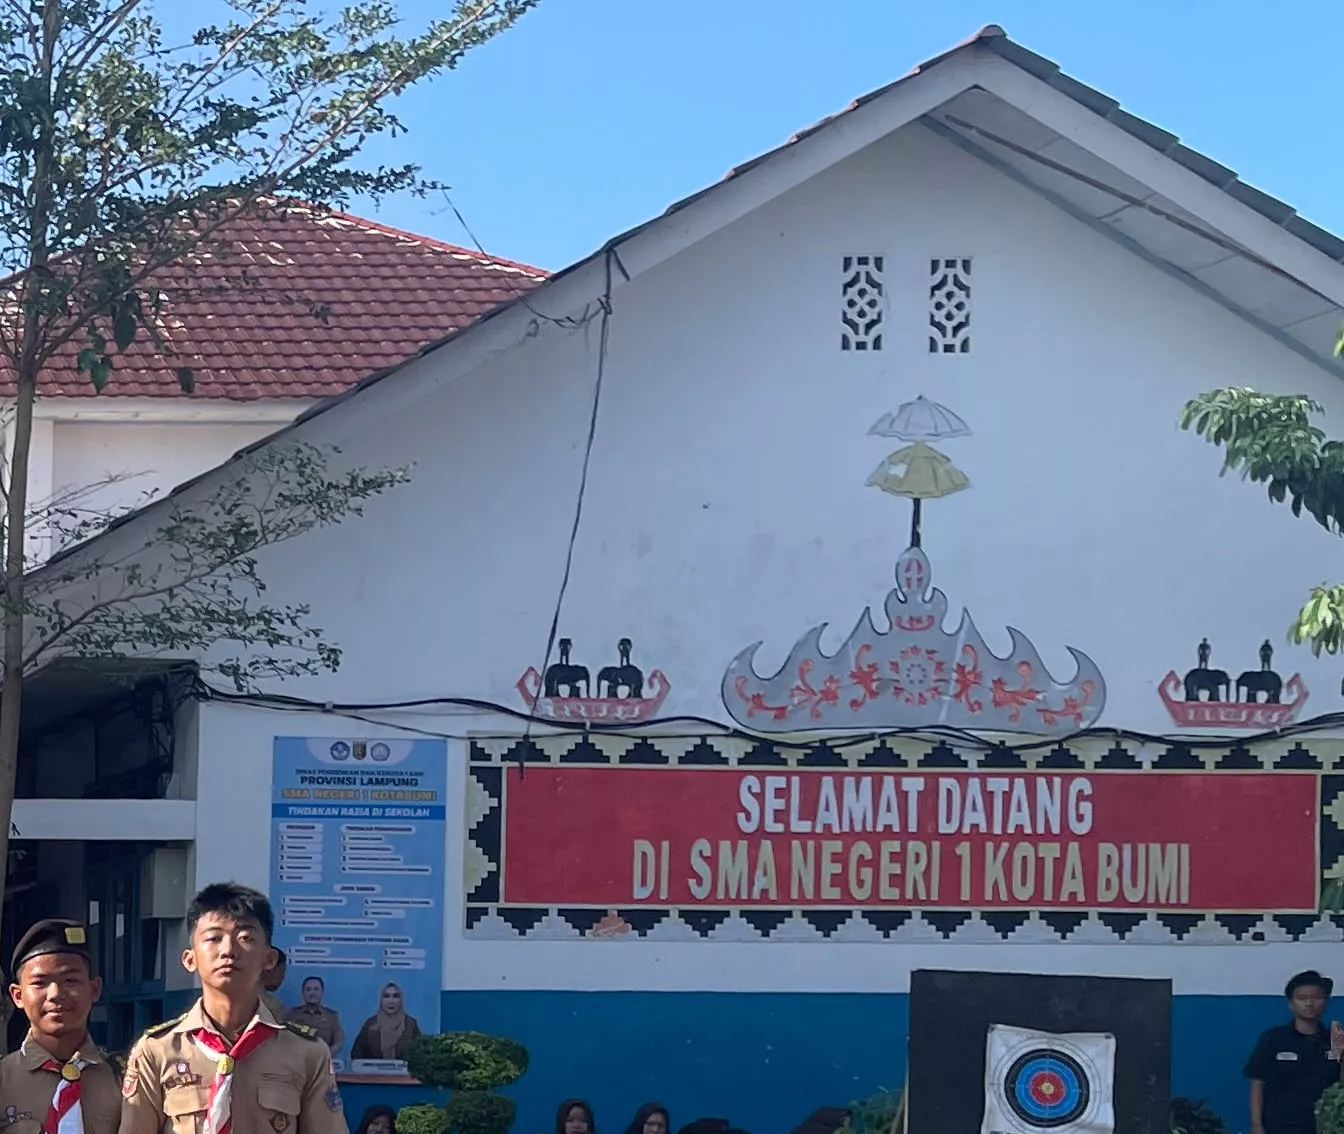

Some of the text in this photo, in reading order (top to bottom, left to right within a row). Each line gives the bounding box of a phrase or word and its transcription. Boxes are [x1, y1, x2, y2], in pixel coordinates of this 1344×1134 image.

[300, 776, 419, 787] PROVINSI LAMPUNG
[282, 788, 310, 799] SMA
[288, 806, 339, 816] TINDAKAN
[736, 775, 1094, 836] SELAMAT DATANG
[632, 839, 1189, 905] DI SMA NEGERI 1 KOTA BUMI
